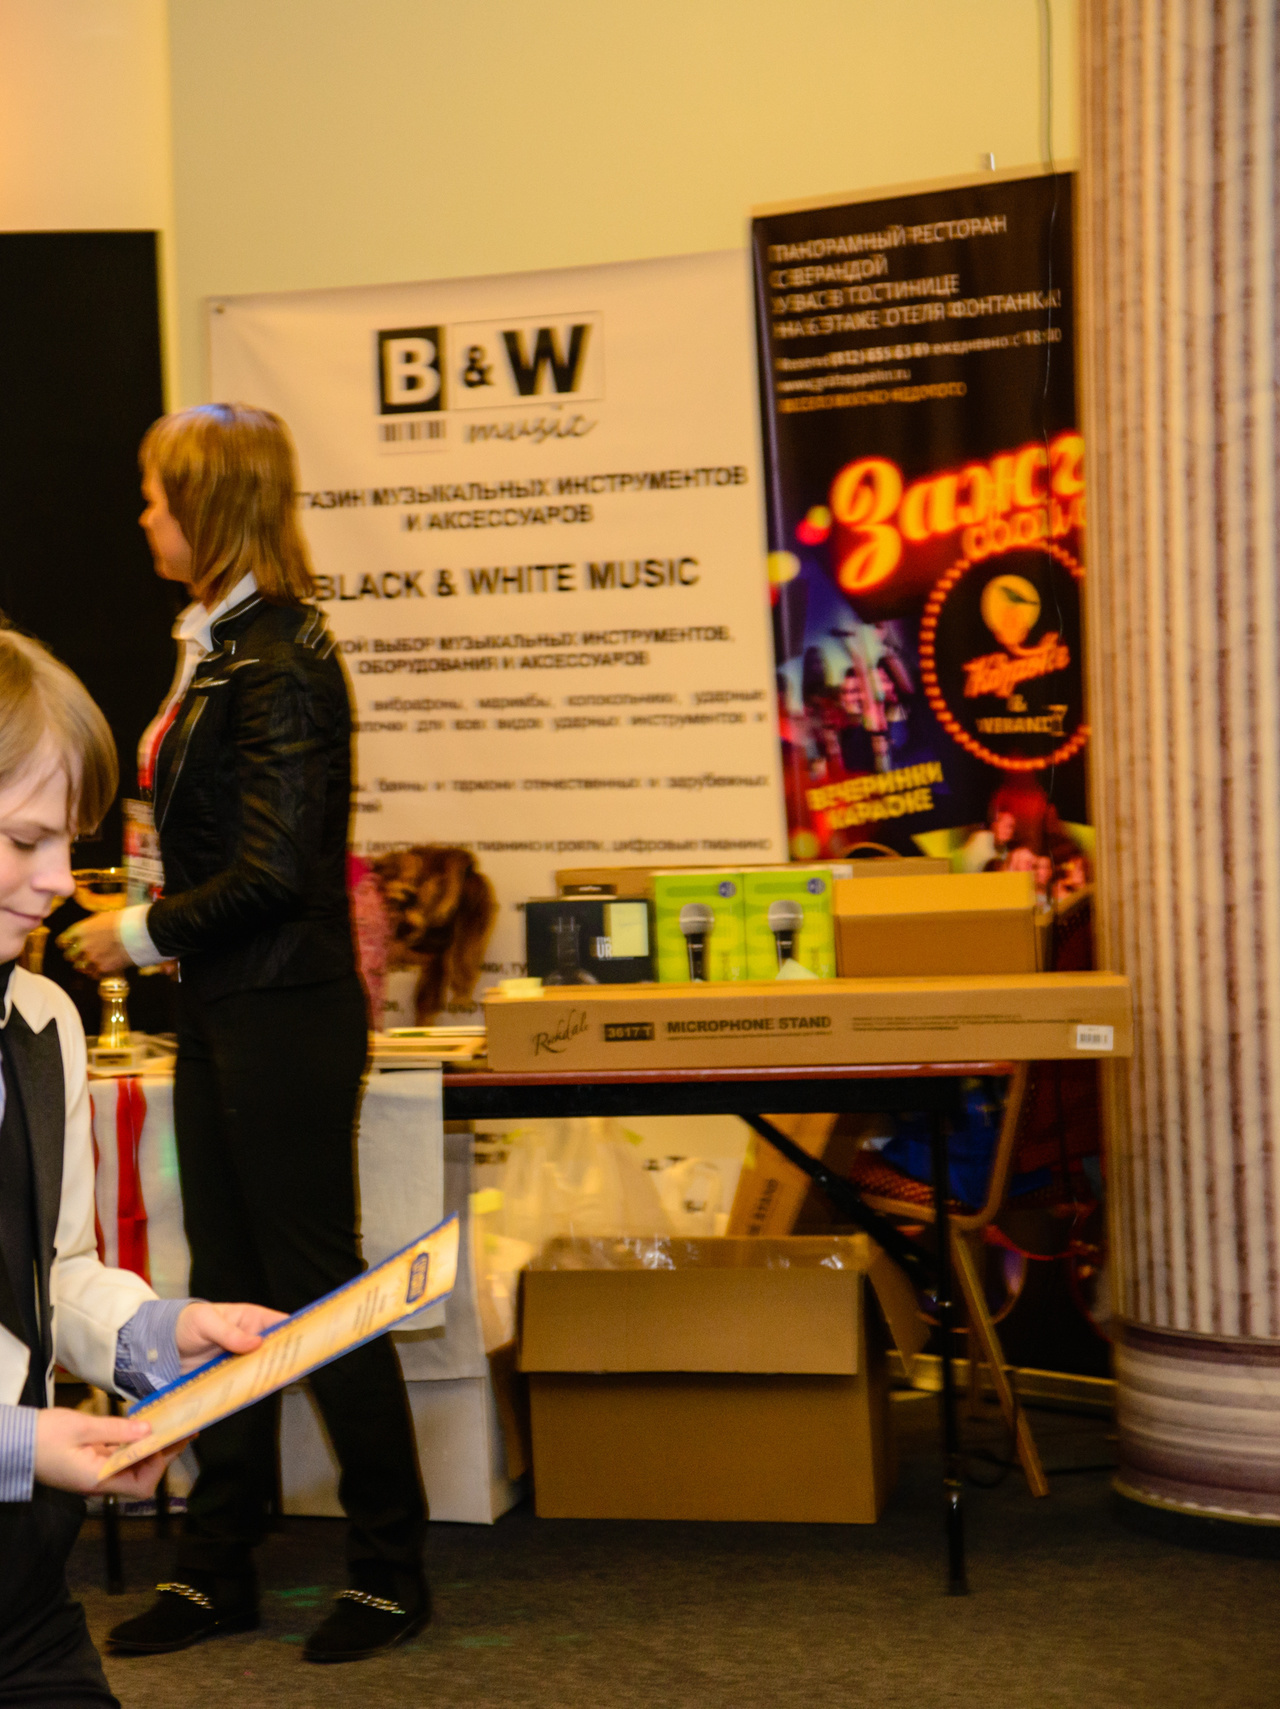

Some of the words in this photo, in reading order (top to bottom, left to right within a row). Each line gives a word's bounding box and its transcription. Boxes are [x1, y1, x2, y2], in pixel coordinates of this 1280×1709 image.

[771, 224, 907, 262] ПАНОРАМНЫЙ
[911, 214, 1008, 243] РЕСТОРАН
[794, 253, 889, 287] ВЕРАНДОЙ
[848, 273, 961, 305] ГОСТИНИЦЕ
[821, 310, 881, 333] ЭТАЖЕ
[885, 302, 946, 327] ОТЕЛЯ
[382, 336, 442, 406] B
[461, 344, 495, 389] &
[497, 322, 594, 397] W
[369, 478, 552, 507] МУЗЫКАЛЬНЫХ
[556, 465, 749, 496] ИНСТРУМЕНТОВ
[404, 512, 422, 531] И
[426, 503, 594, 530] АКСЕССУАРОВ
[313, 571, 426, 601] BLACK
[434, 568, 457, 597] &
[465, 563, 577, 596] WHITE
[586, 556, 701, 591] MUSIC
[372, 637, 434, 653] ВЫБОР
[438, 630, 578, 651] МУЗЫКАЛЬНЫХ
[356, 656, 498, 674] ОБОРУДОВАНИЯ
[518, 650, 651, 669] АКСЕССУАРОВ
[666, 1018, 774, 1034] MICROPHONE
[778, 1016, 832, 1030] STAND
